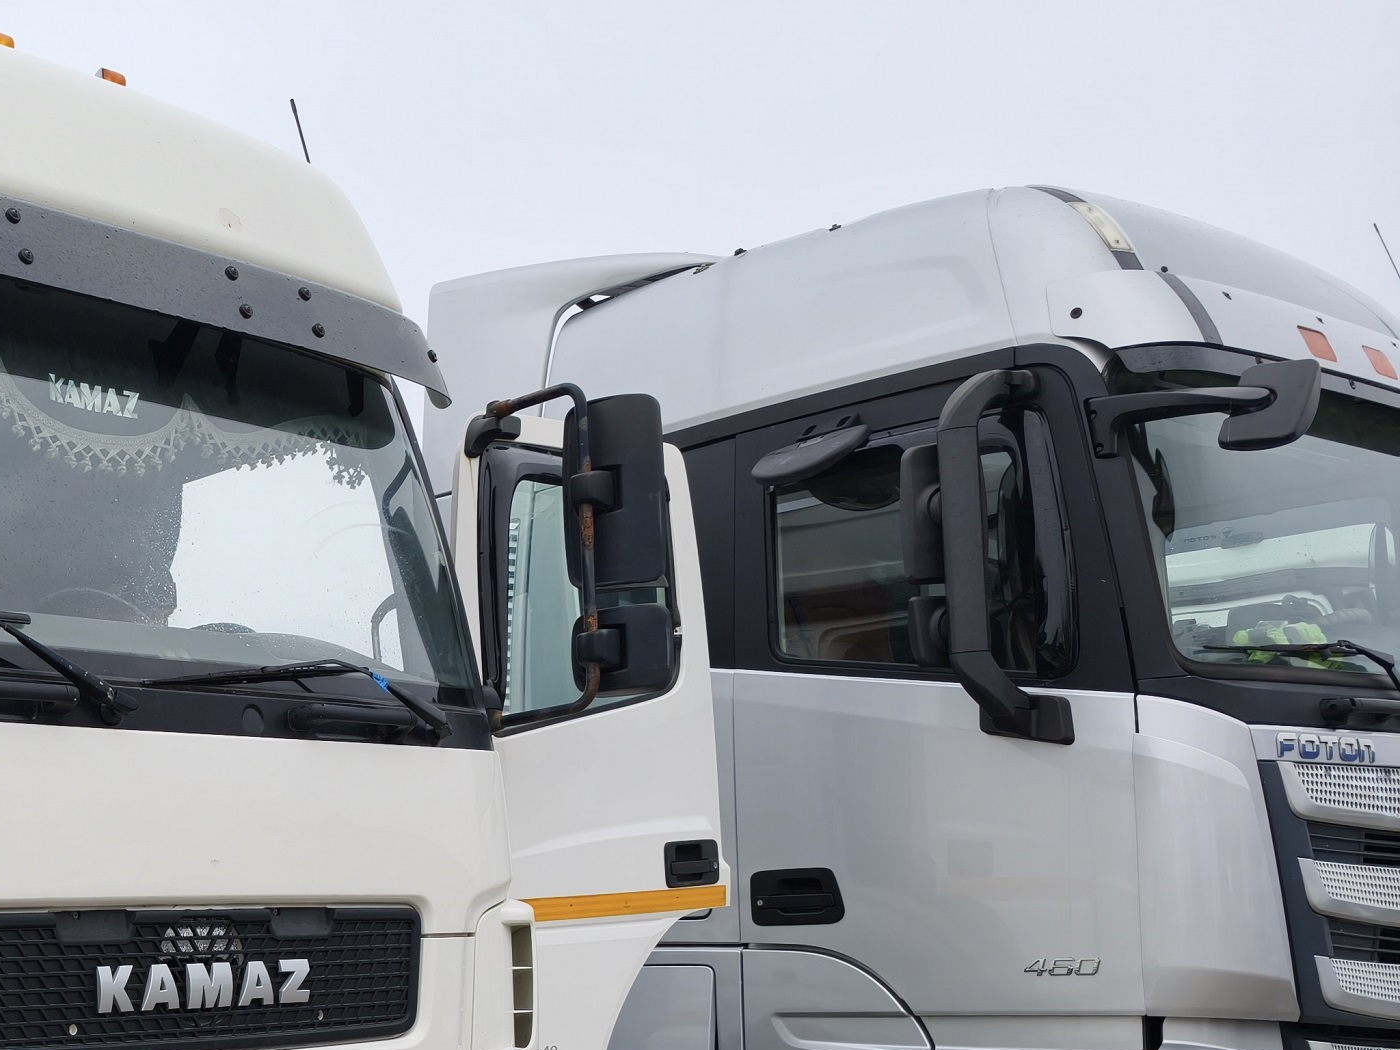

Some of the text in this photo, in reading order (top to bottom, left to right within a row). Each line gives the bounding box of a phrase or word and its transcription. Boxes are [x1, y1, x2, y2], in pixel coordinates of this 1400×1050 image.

[48, 372, 140, 419] KAMAZ
[96, 958, 311, 1014] KAMAZ
[1023, 956, 1101, 977] 460
